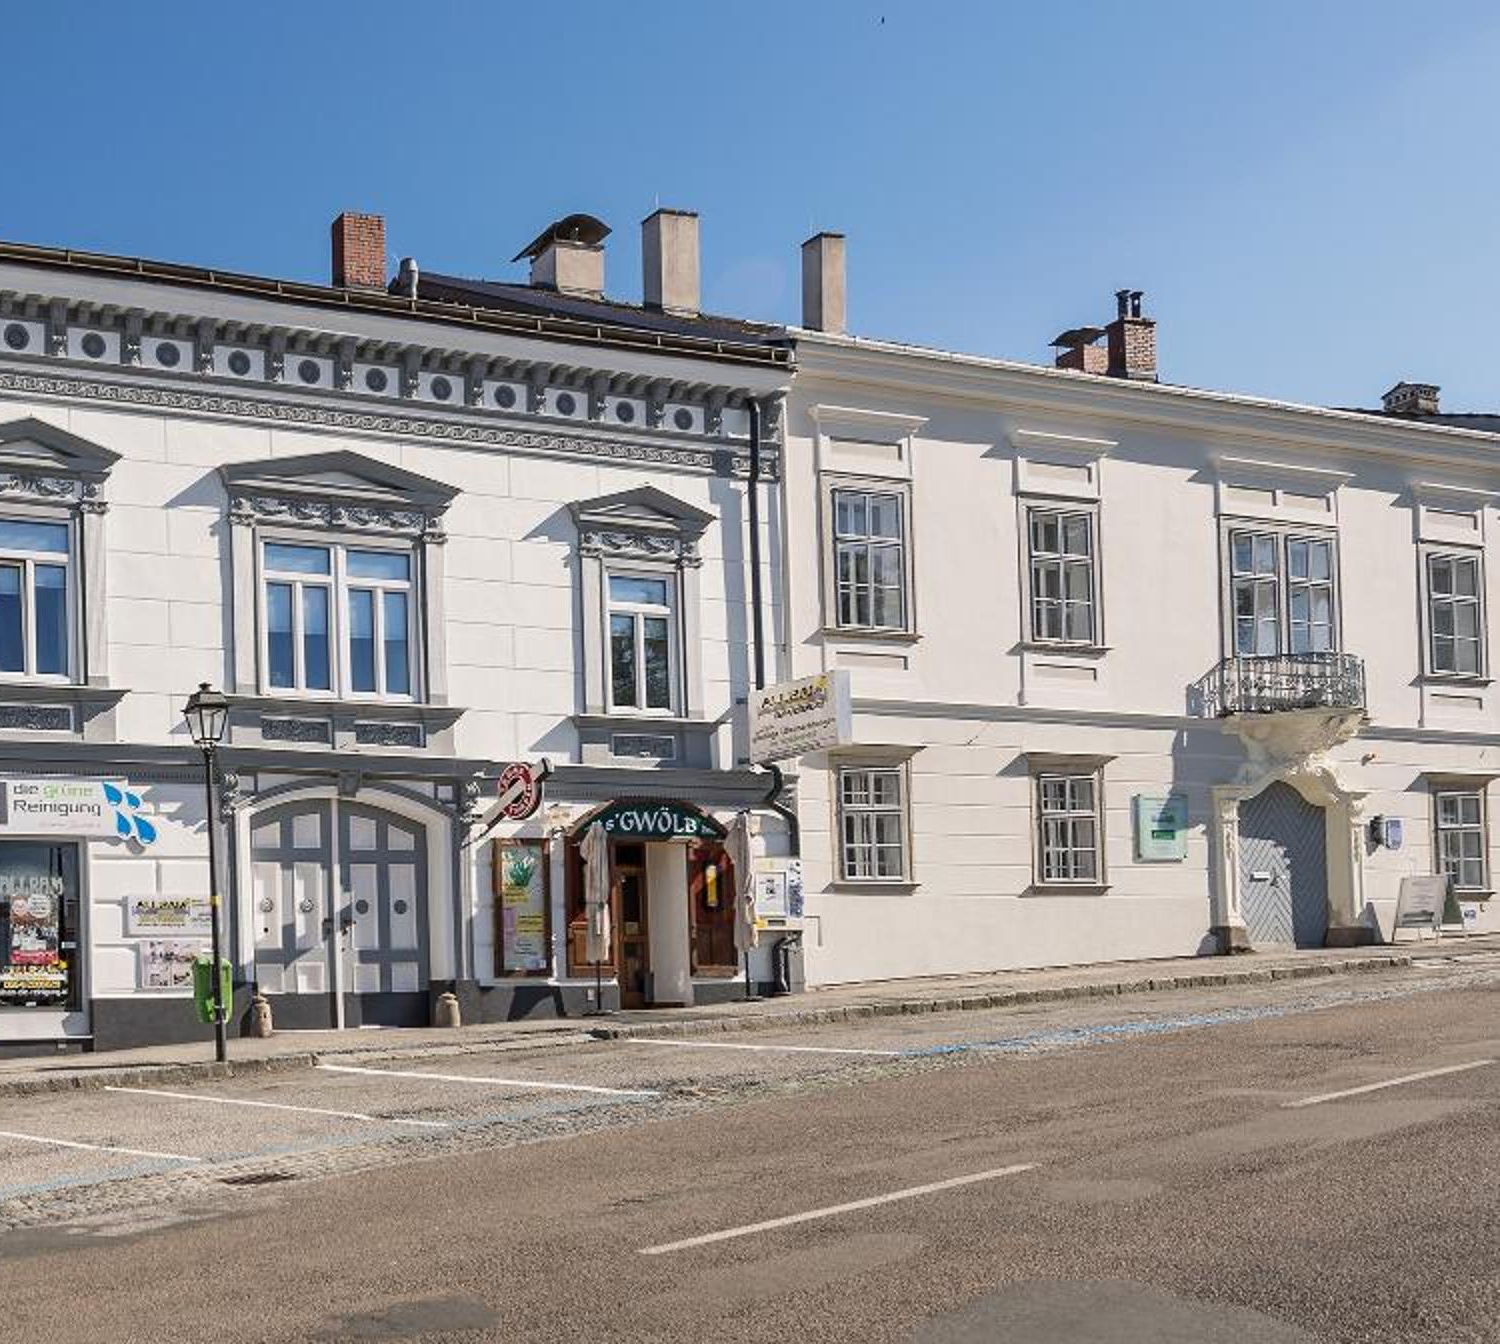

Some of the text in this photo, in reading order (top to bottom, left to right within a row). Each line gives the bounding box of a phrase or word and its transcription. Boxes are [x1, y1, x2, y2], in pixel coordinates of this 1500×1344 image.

[13, 783, 94, 799] die grüne
[12, 799, 101, 817] Reinigung
[0, 875, 64, 897] ALLRAM
